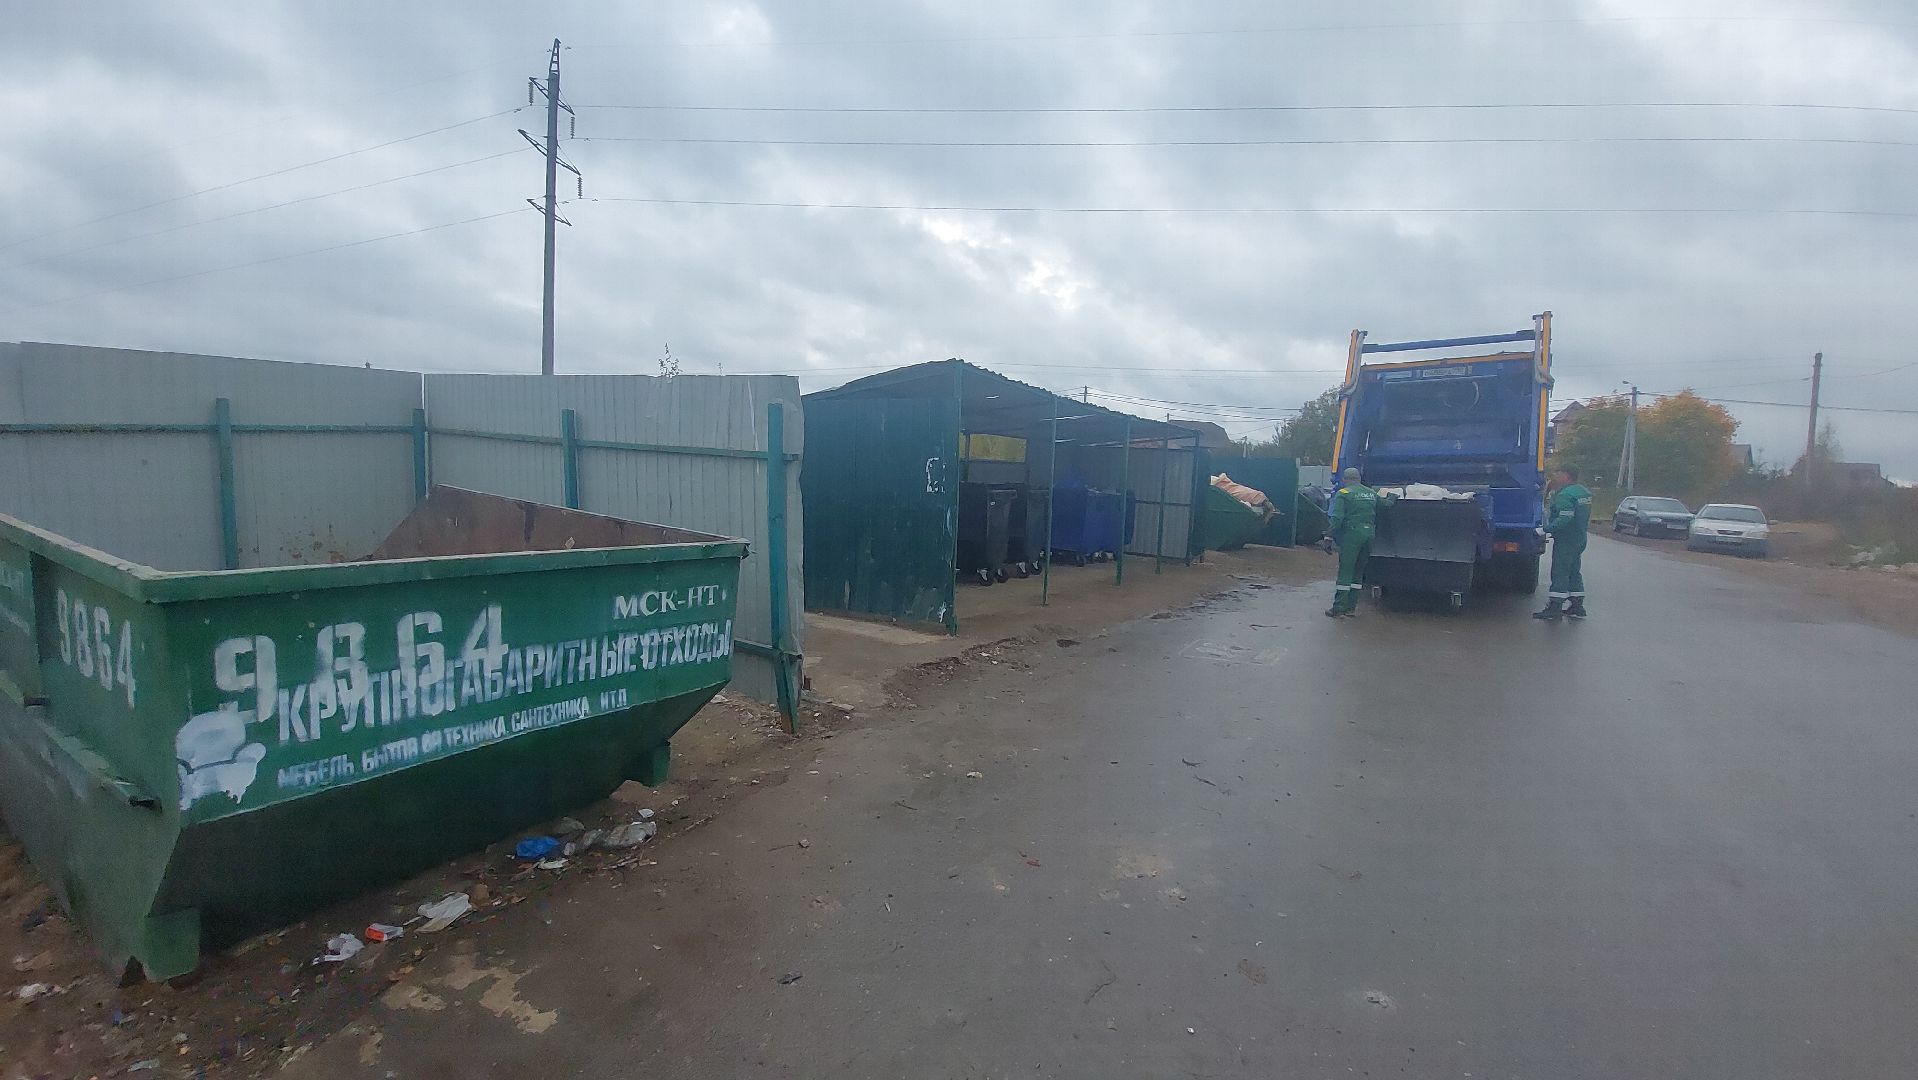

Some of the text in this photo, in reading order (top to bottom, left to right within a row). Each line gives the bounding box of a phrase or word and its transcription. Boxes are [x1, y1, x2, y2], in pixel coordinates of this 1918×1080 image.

[57, 586, 136, 710] 9864
[214, 603, 509, 723] 9864
[639, 619, 732, 670] ОТХОДЫ
